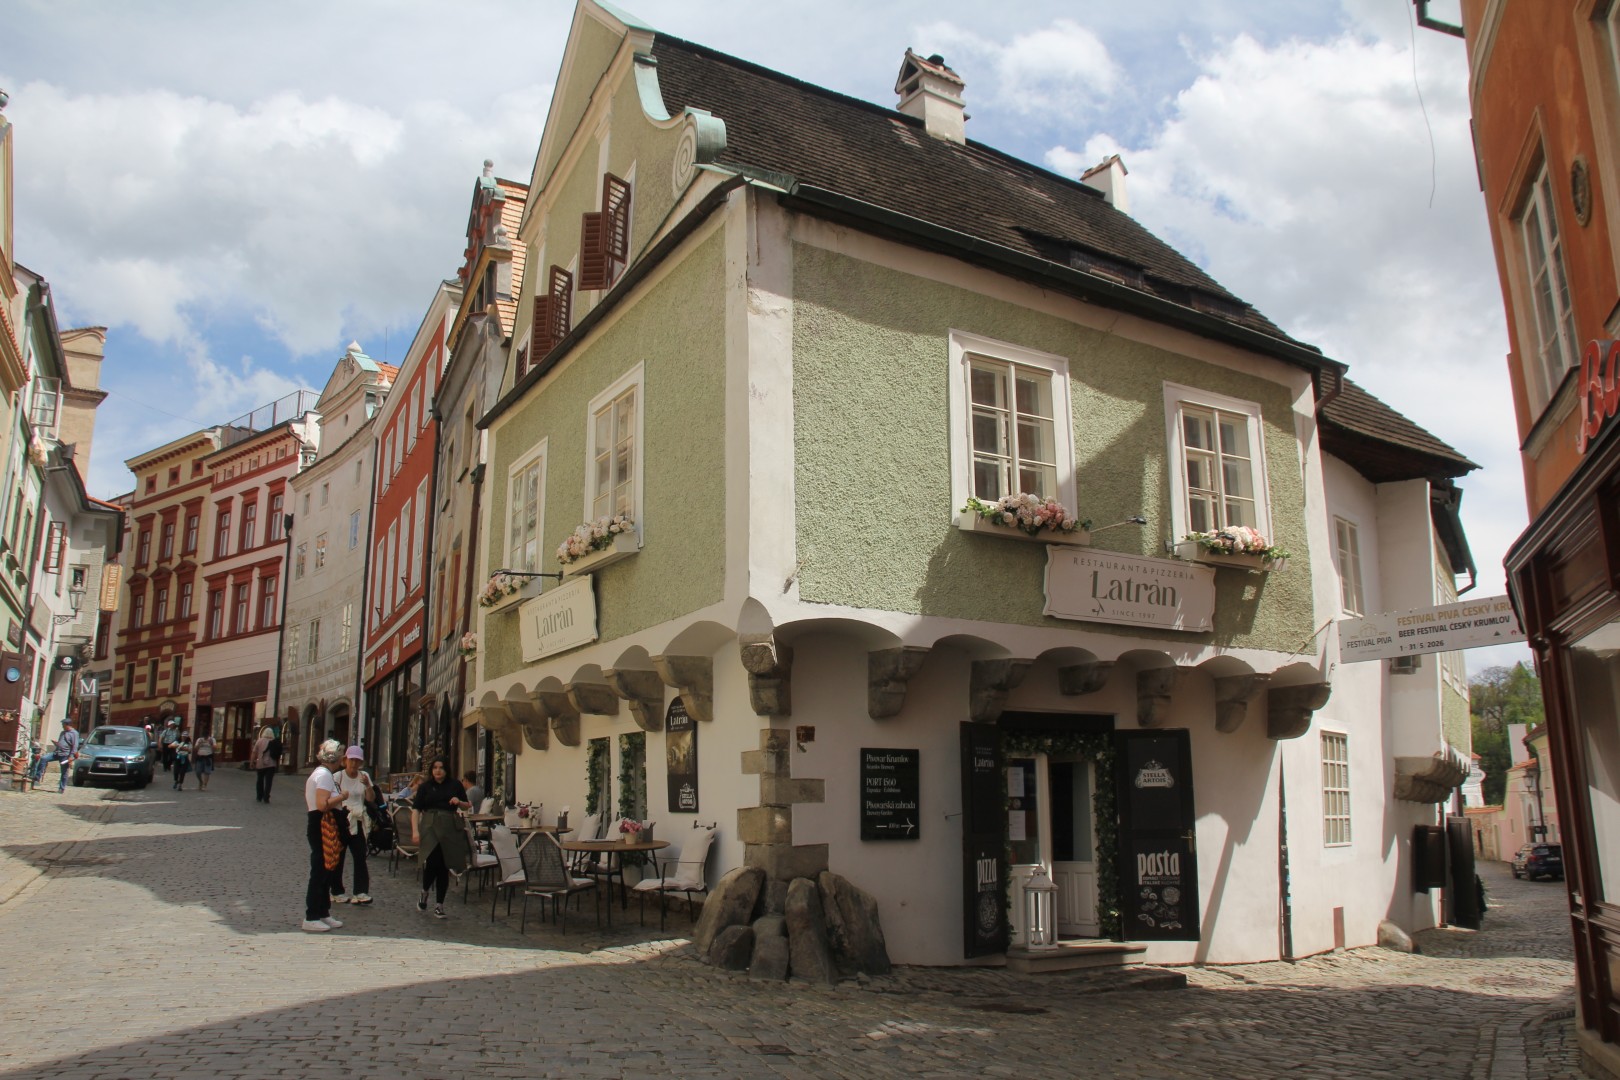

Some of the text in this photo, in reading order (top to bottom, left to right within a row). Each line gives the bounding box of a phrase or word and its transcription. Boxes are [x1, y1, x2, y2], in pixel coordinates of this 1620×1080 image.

[1073, 557, 1140, 573] RESTAURANT
[1150, 568, 1195, 580] PIZZERIA
[1090, 570, 1177, 608] Latrán
[535, 605, 574, 639] Latrán
[1112, 609, 1135, 617] SINCE
[1397, 612, 1436, 626] FESTIVAL
[1438, 609, 1460, 621] PIVA
[1494, 601, 1513, 612] KRU
[1399, 628, 1415, 638] BEER
[1417, 624, 1448, 635] FESTIVAL
[1474, 615, 1511, 628] KRUMLOV
[1346, 636, 1393, 649] FESTIVAL PIVA
[1427, 640, 1444, 648] 2026
[80, 678, 97, 694] M
[886, 754, 909, 763] Krumlov
[866, 777, 883, 786] PORT
[976, 852, 997, 893] pizza
[1137, 849, 1180, 885] pasta
